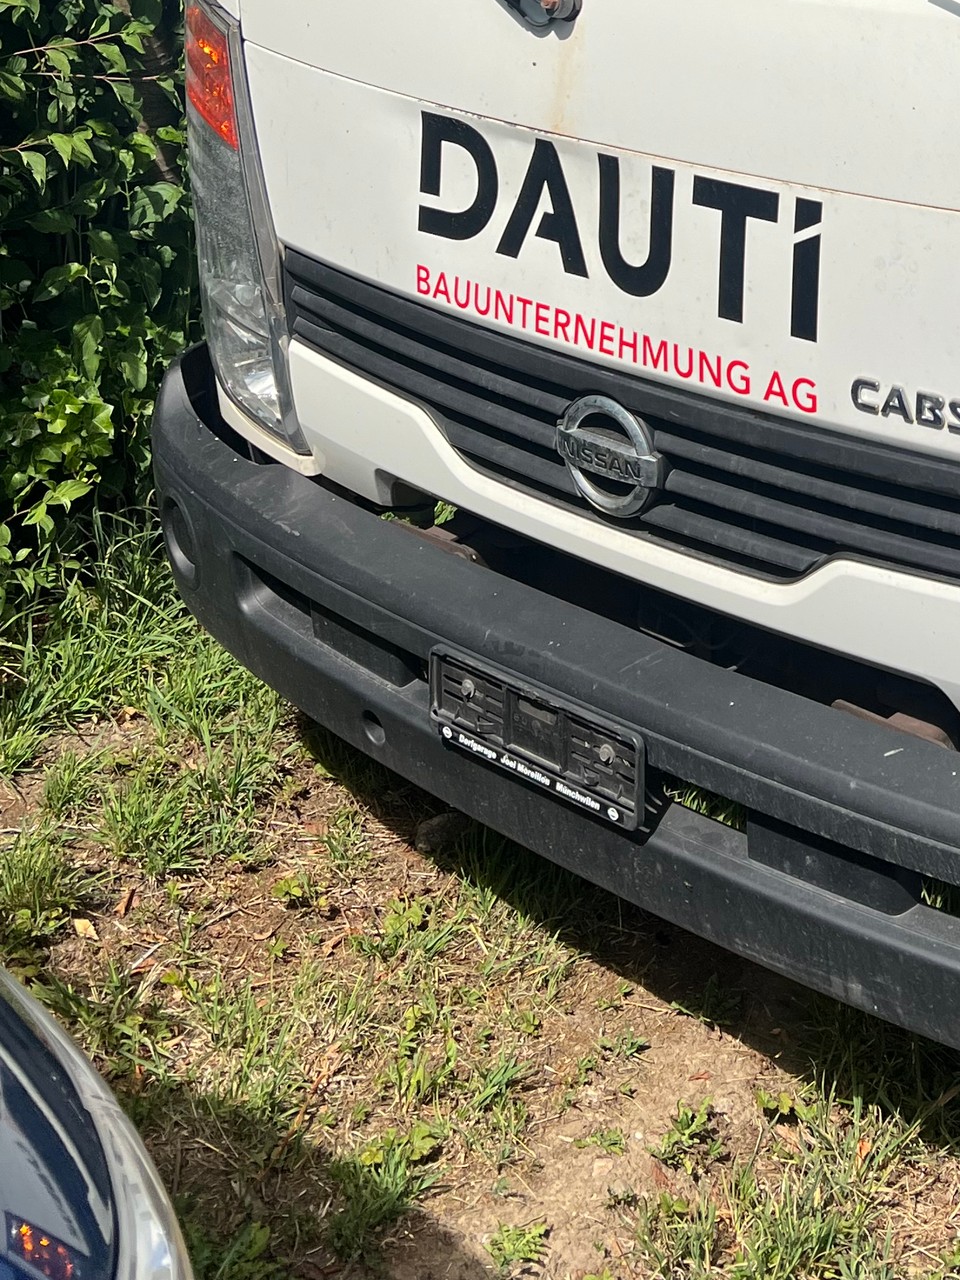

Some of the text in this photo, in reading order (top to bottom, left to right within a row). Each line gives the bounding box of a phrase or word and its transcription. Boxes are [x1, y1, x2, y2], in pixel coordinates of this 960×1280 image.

[416, 264, 818, 414] BAUUNTERNEHMUNG AG
[559, 431, 643, 481] NISSAN
